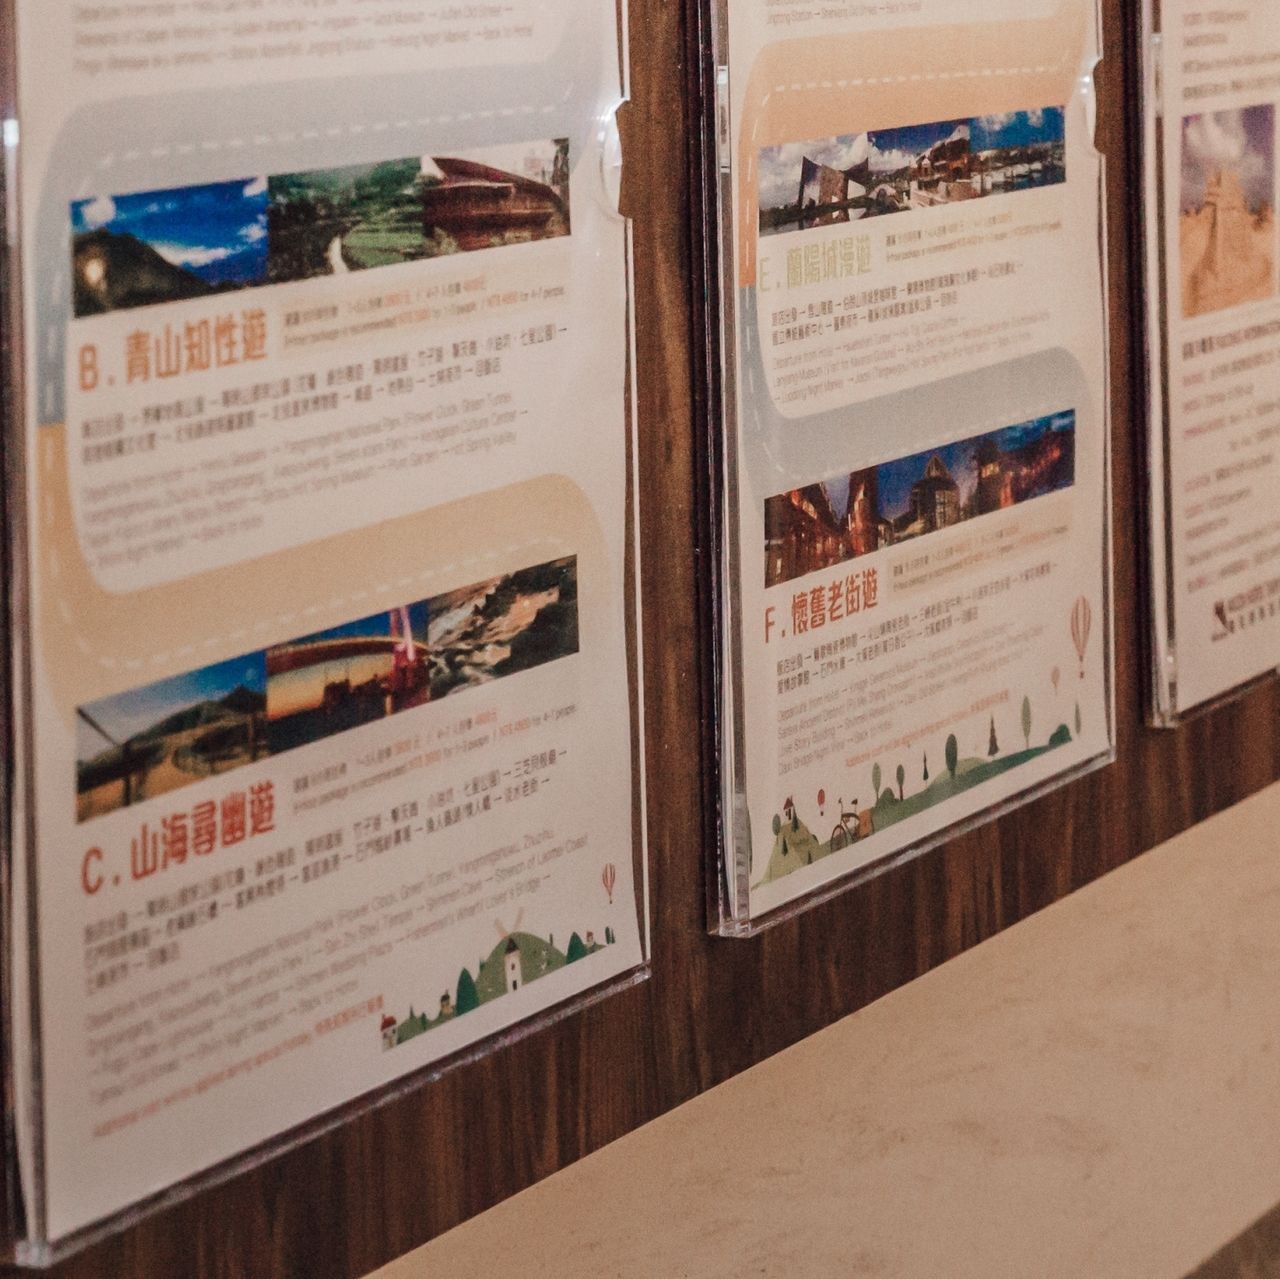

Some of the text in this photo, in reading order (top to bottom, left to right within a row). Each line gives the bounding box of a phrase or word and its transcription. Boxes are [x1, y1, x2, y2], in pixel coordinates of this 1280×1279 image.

[792, 567, 878, 636] 懷舊老街遊
